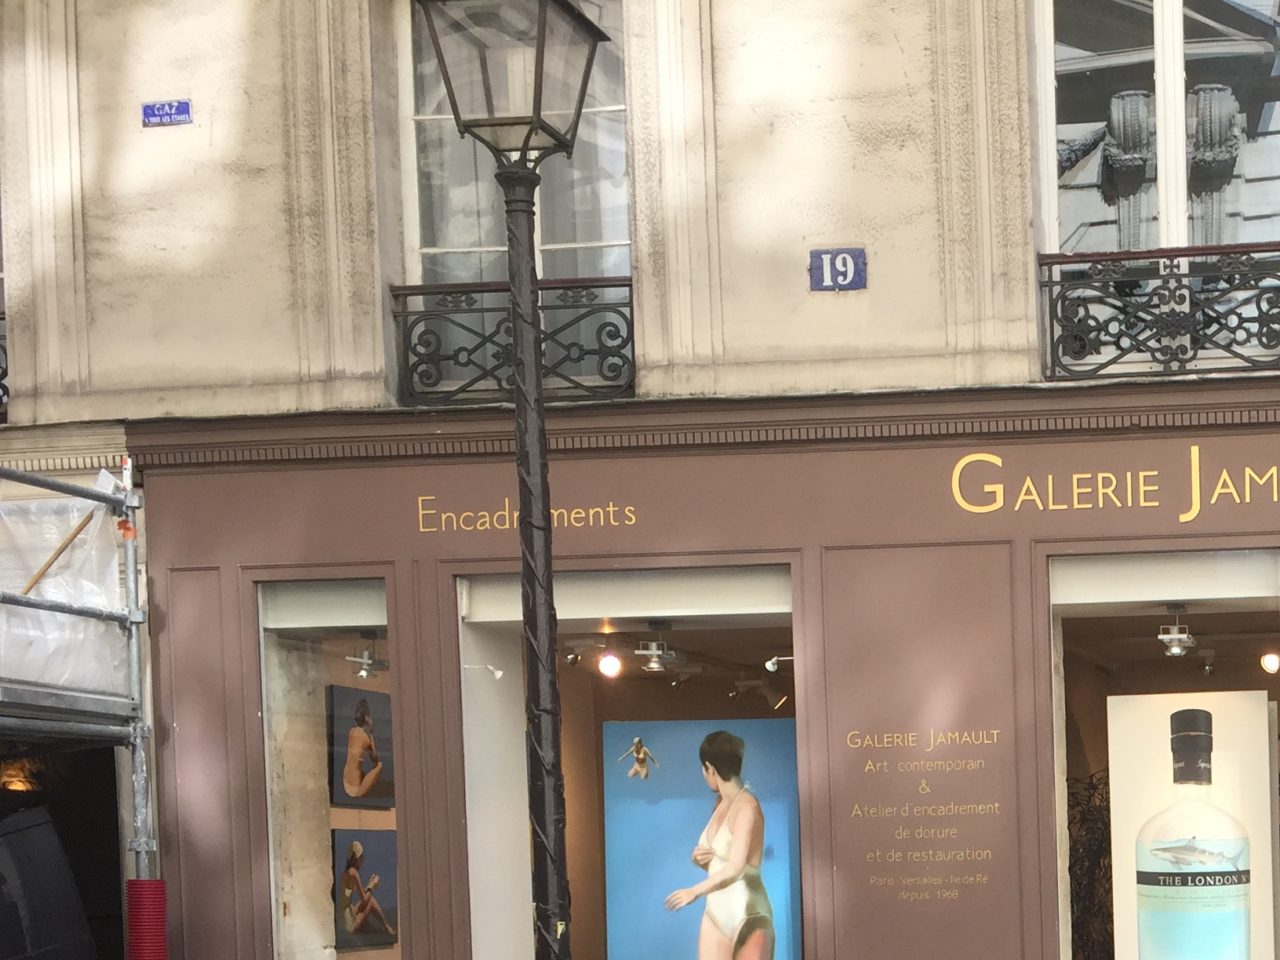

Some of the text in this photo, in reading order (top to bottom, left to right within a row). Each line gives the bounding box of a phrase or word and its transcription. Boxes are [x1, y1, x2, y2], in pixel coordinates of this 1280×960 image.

[154, 102, 178, 115] GAZ
[821, 253, 855, 286] 19
[951, 452, 1160, 513] GALERIE
[417, 495, 637, 532] Encadrments
[847, 728, 1000, 751] GALERIE JAMAULT
[864, 757, 985, 773] Art contemporain
[918, 779, 931, 793] &
[851, 804, 897, 818] Atelier
[895, 826, 958, 839] de dorure
[866, 847, 992, 863] et de restauration
[1158, 876, 1182, 886] THE
[1187, 875, 1238, 886] LONDON
[899, 891, 930, 902] depuis
